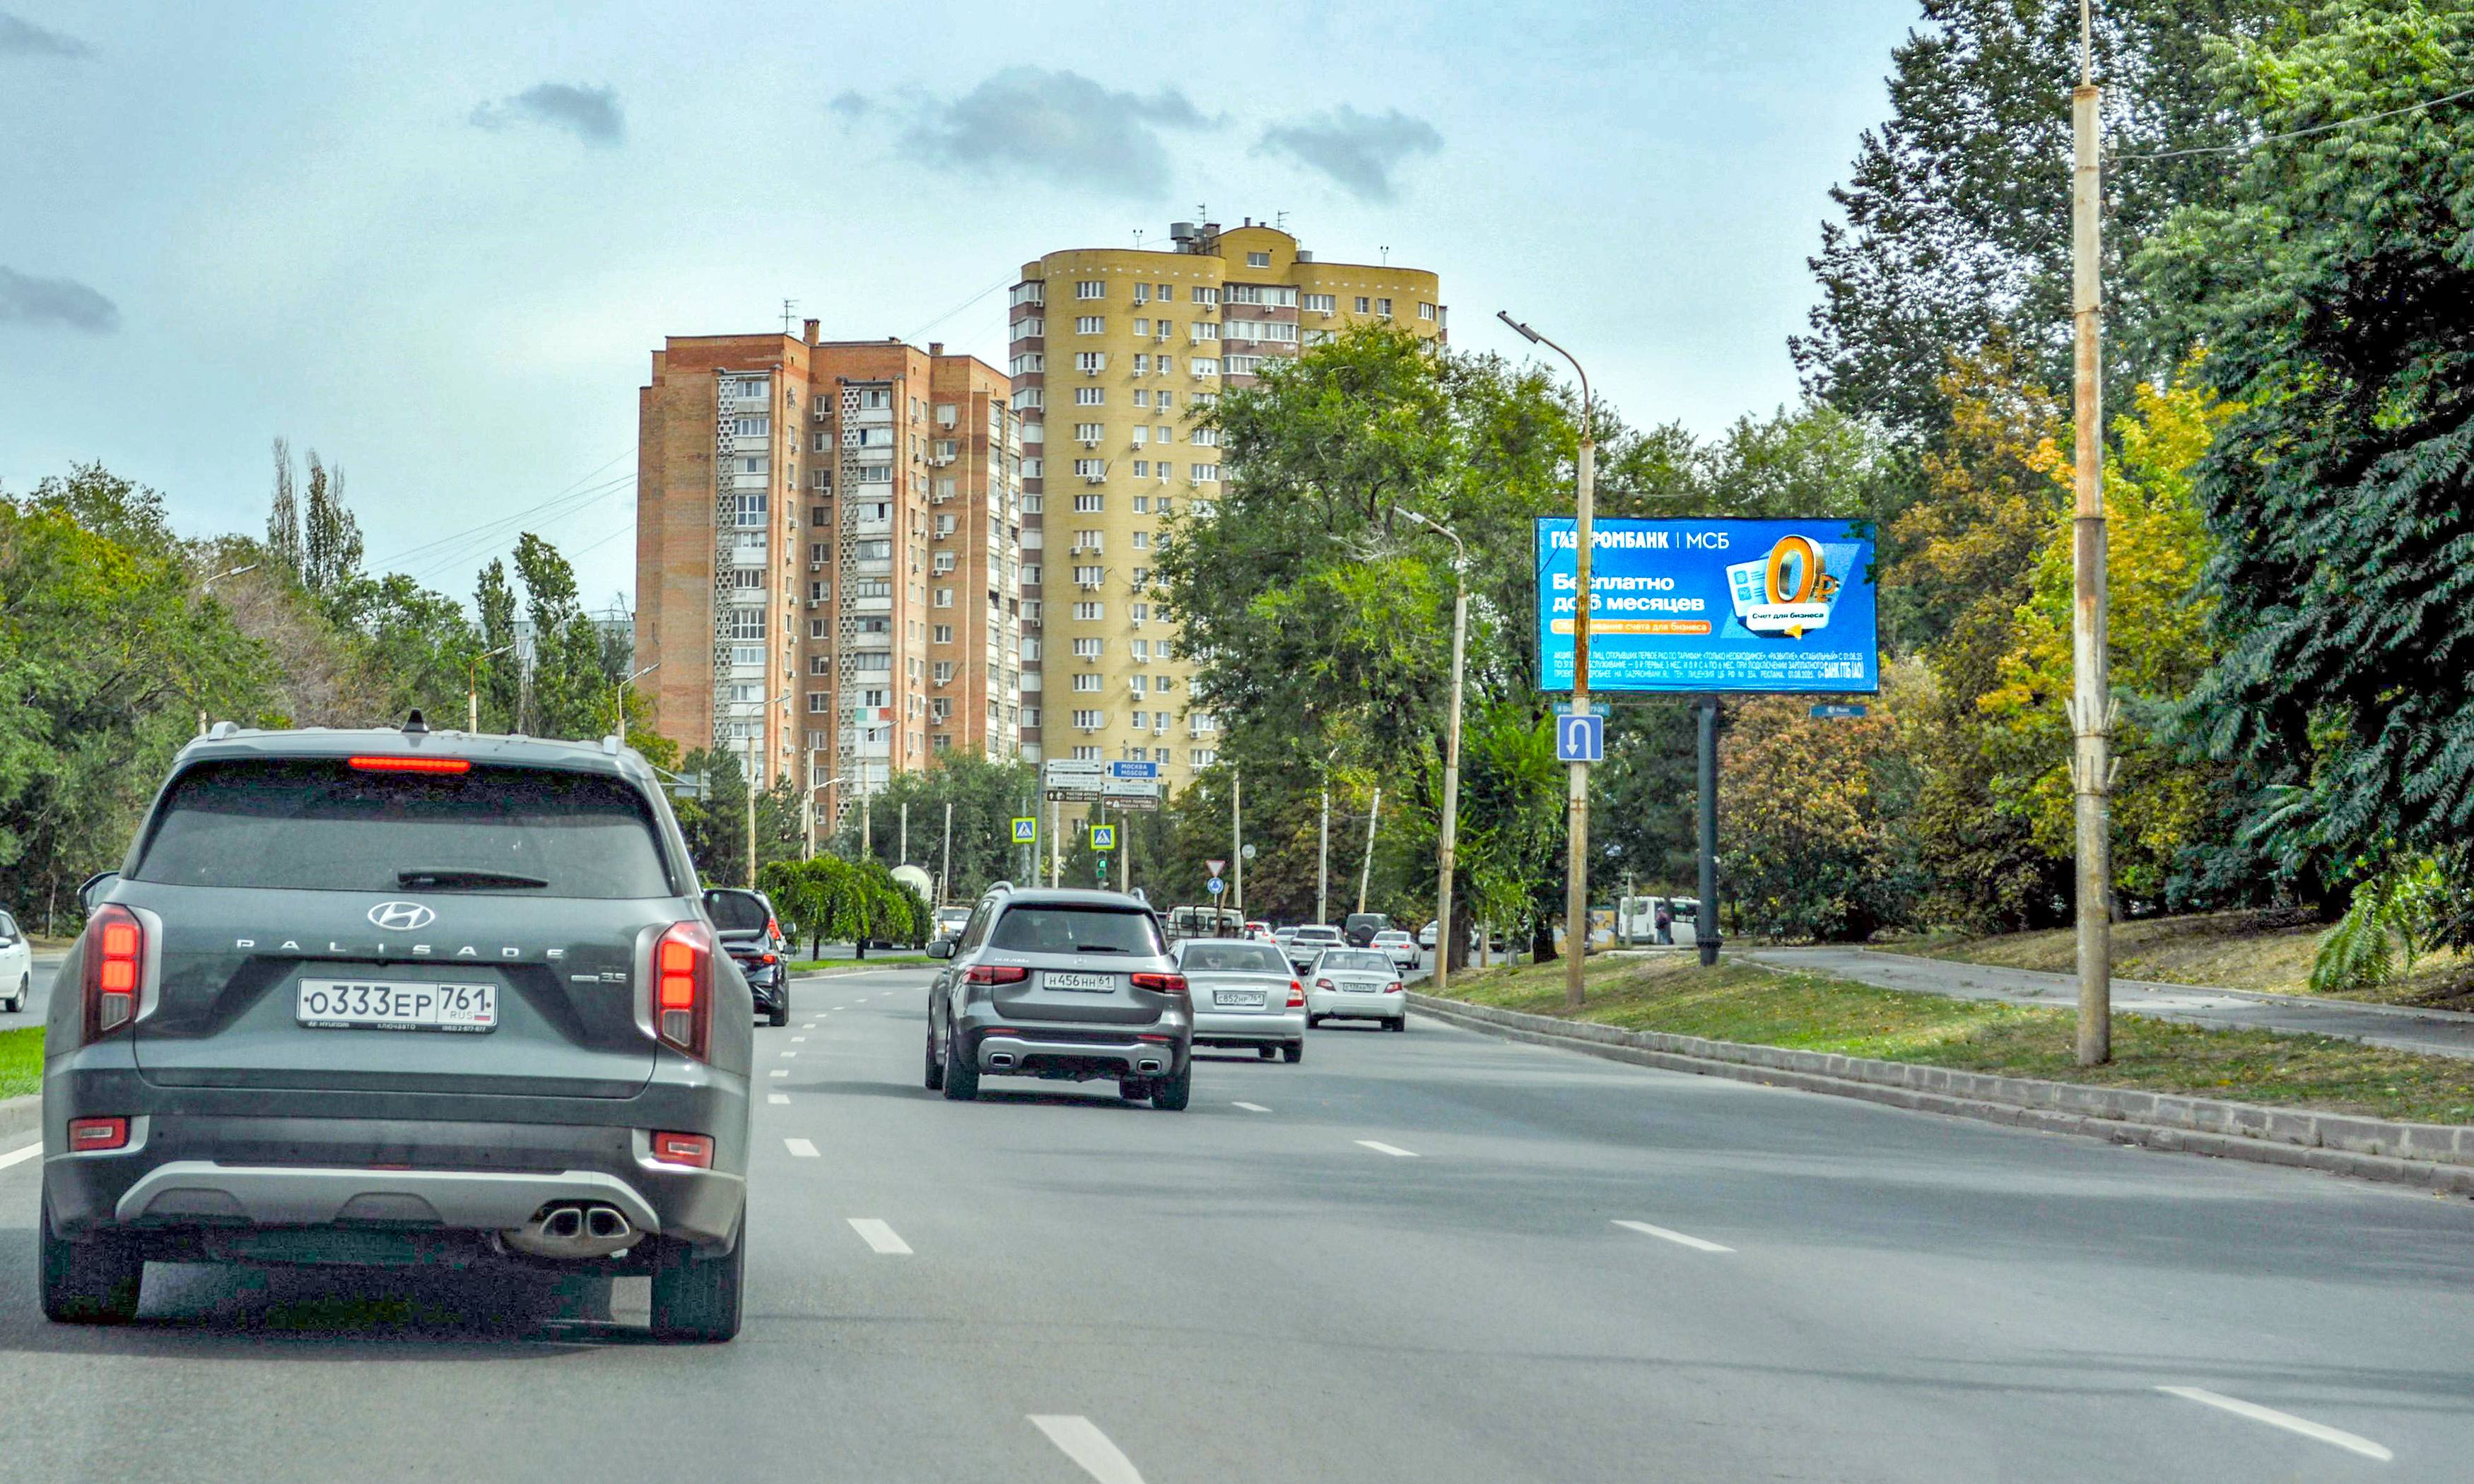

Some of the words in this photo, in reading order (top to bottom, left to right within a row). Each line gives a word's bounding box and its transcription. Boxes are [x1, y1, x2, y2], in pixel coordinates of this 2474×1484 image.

[1551, 531, 1669, 548] ГАЗРОМБАНК
[1687, 532, 1730, 549] МСБ
[1553, 596, 1577, 612] до
[1607, 597, 1705, 613] месяцев
[1671, 622, 1707, 630] бизнеса
[1824, 661, 1839, 678] БАНК
[236, 939, 564, 960] PALISADE
[1049, 974, 1096, 987] Н456НН
[310, 985, 432, 1018] О333ЕР
[440, 987, 486, 1011] 761
[450, 1011, 474, 1020] RUS
